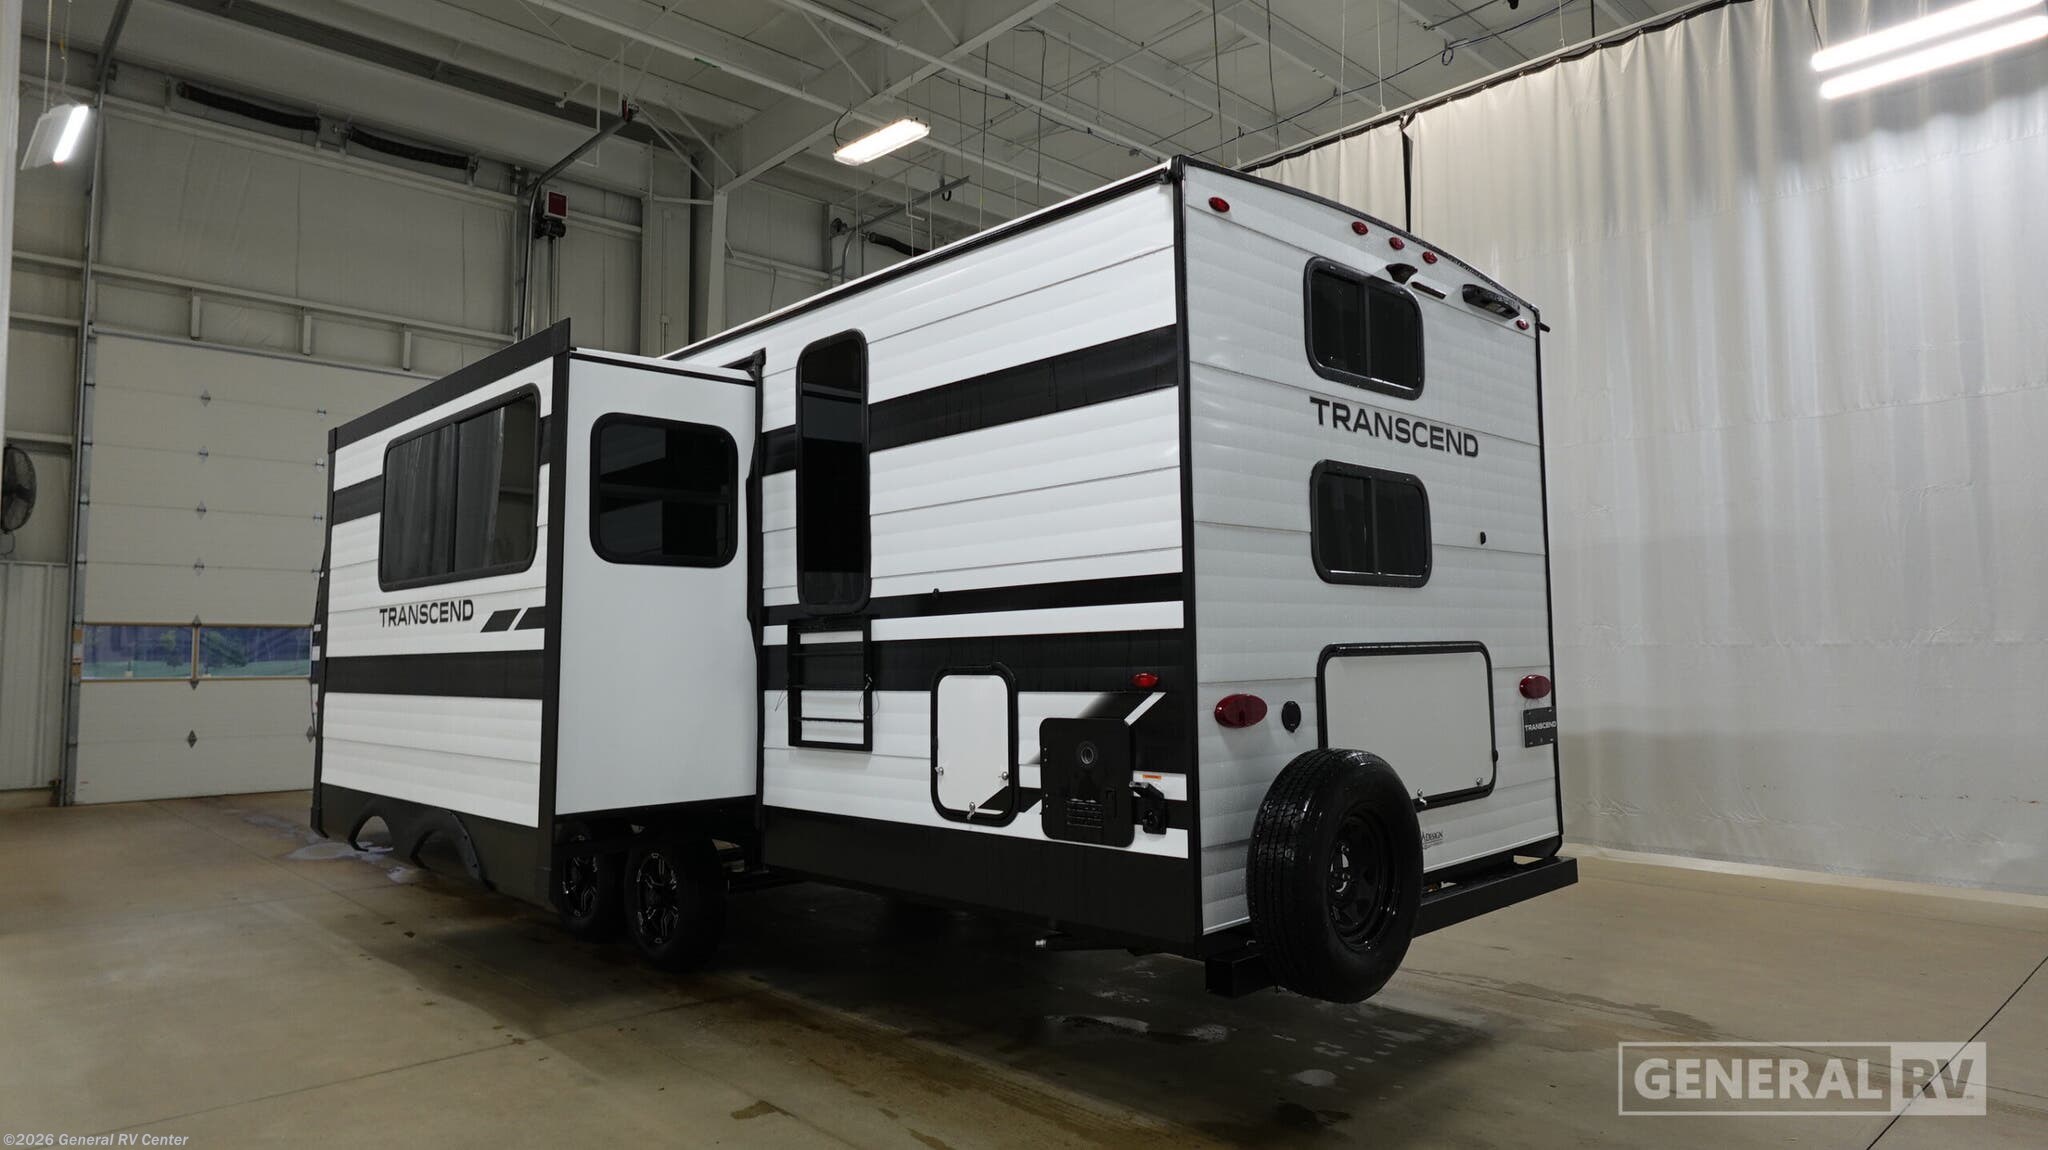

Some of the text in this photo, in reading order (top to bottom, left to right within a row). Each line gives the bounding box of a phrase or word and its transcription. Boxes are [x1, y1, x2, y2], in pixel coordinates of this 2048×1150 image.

[1309, 396, 1479, 458] TRANSCEND
[379, 599, 474, 628] TRANSCEND
[1524, 720, 1557, 731] TRANSCEND
